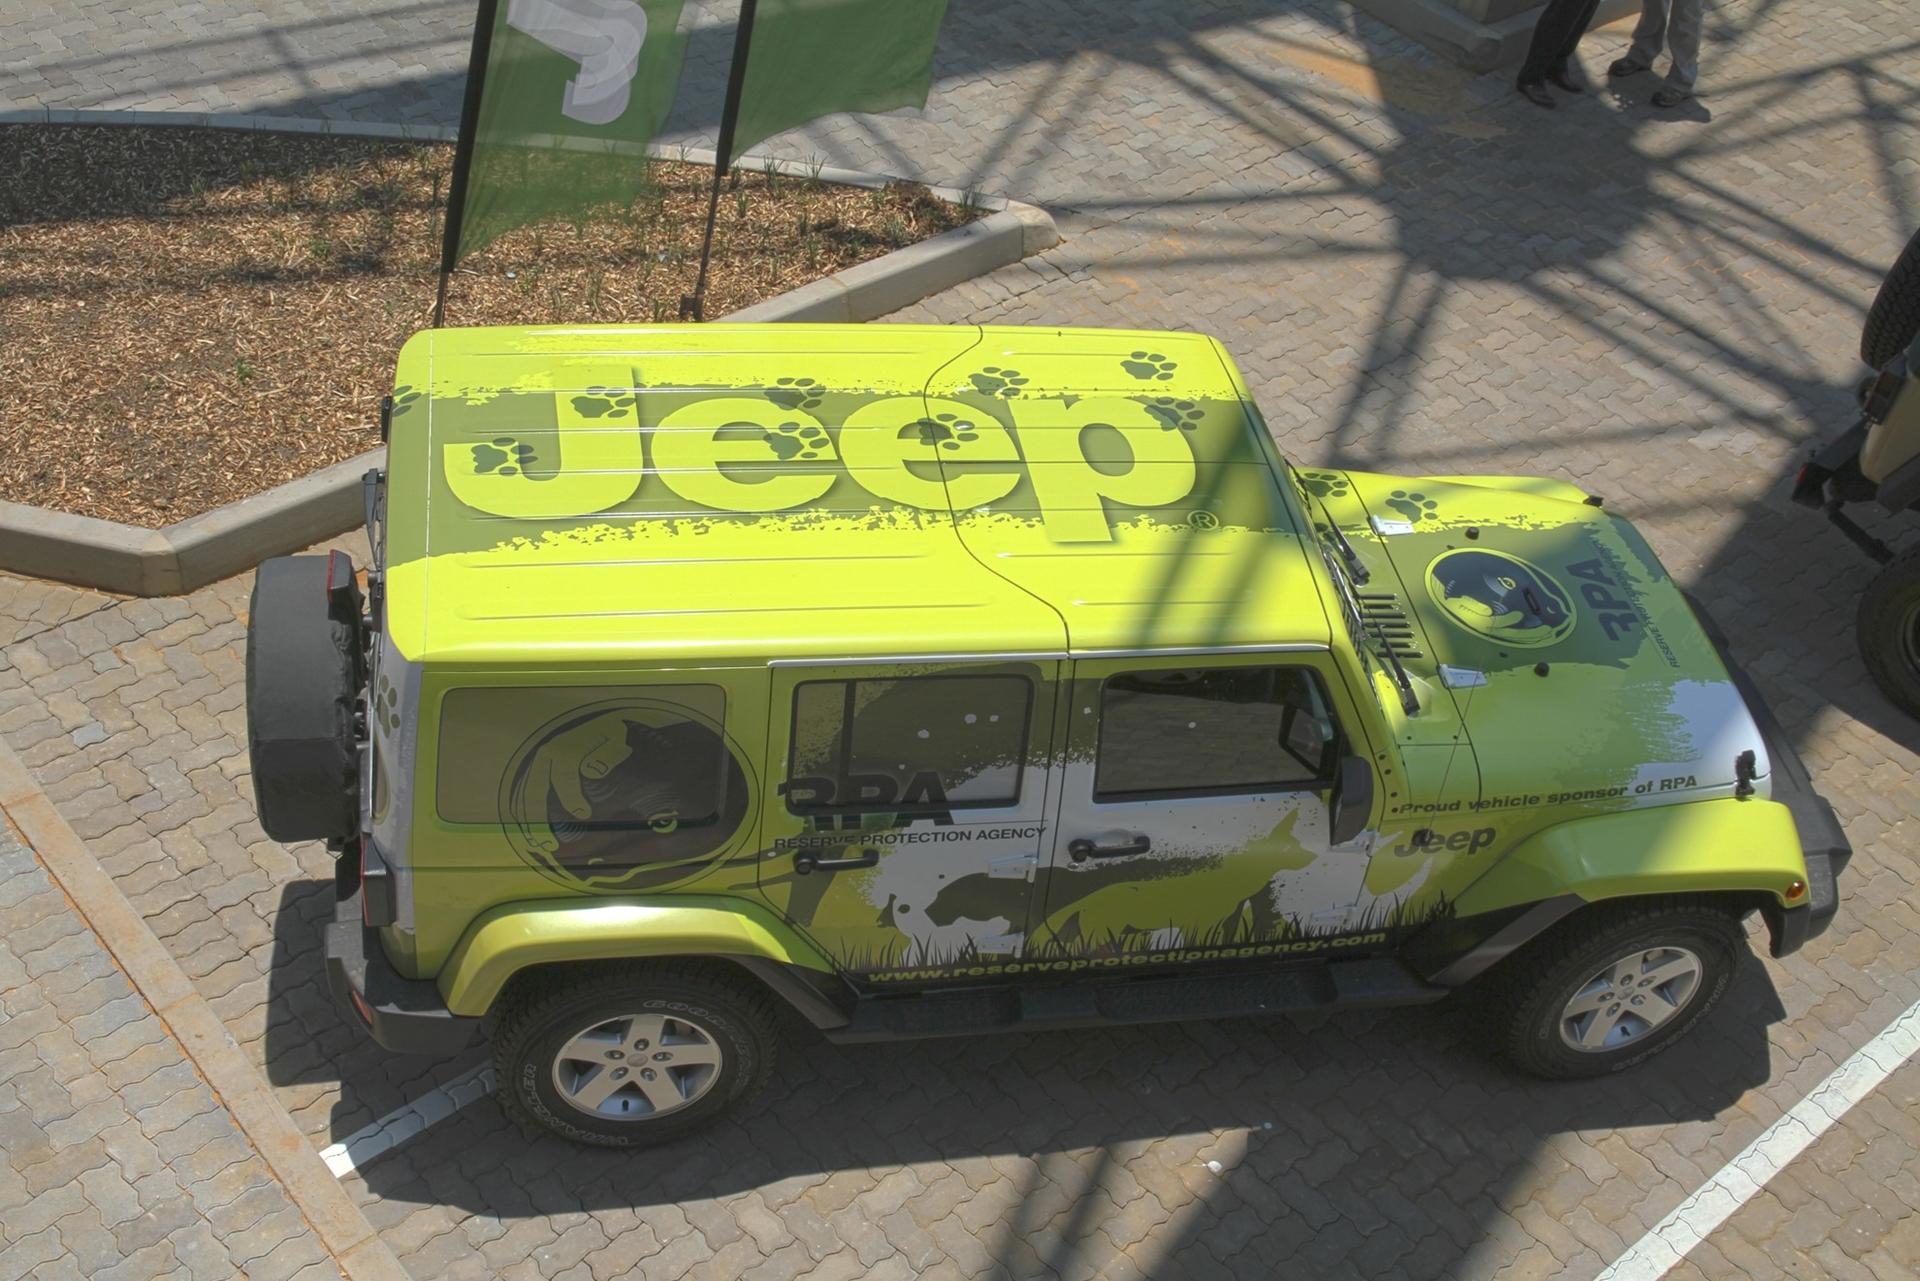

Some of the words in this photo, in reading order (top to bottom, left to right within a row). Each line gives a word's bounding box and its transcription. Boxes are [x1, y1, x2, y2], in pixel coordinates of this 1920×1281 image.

[443, 364, 1197, 543] Jeep
[1565, 558, 1639, 641] RPA
[778, 771, 954, 831] RPA
[1401, 800, 1461, 814] Proud
[1468, 793, 1540, 810] vehicle
[1547, 785, 1628, 805] sponsor
[1635, 780, 1653, 794] of
[1659, 775, 1697, 792] RPA
[774, 835, 856, 850] RESERVE
[860, 831, 972, 845] PROTECTION
[976, 826, 1047, 841] AGENCY
[1394, 826, 1496, 858] Jeep
[868, 930, 1388, 983] www.reserveprotectionagency.com
